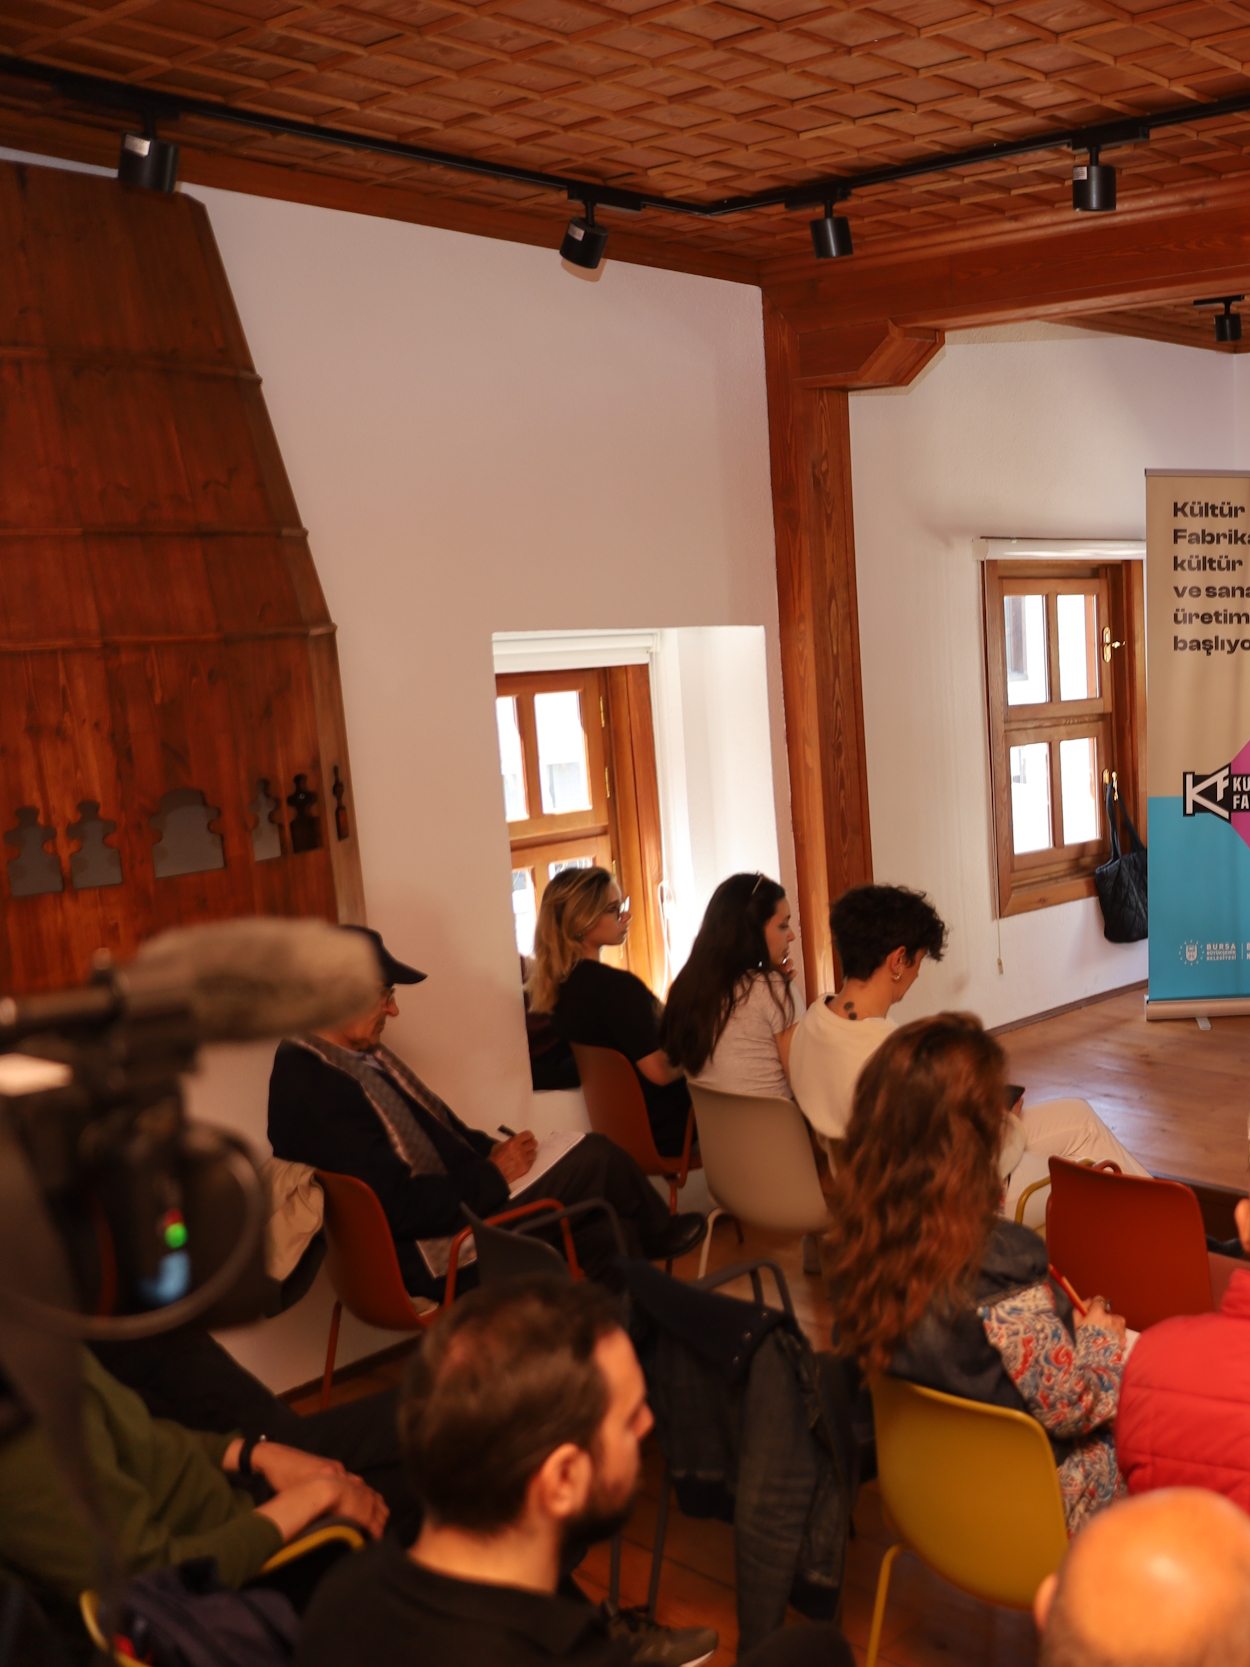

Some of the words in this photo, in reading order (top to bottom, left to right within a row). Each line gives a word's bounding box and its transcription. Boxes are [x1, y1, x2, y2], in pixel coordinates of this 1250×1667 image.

[1173, 501, 1245, 518] Kültür
[1173, 555, 1243, 571] kültür
[1173, 586, 1202, 598] ve
[1206, 943, 1236, 951] BURSA
